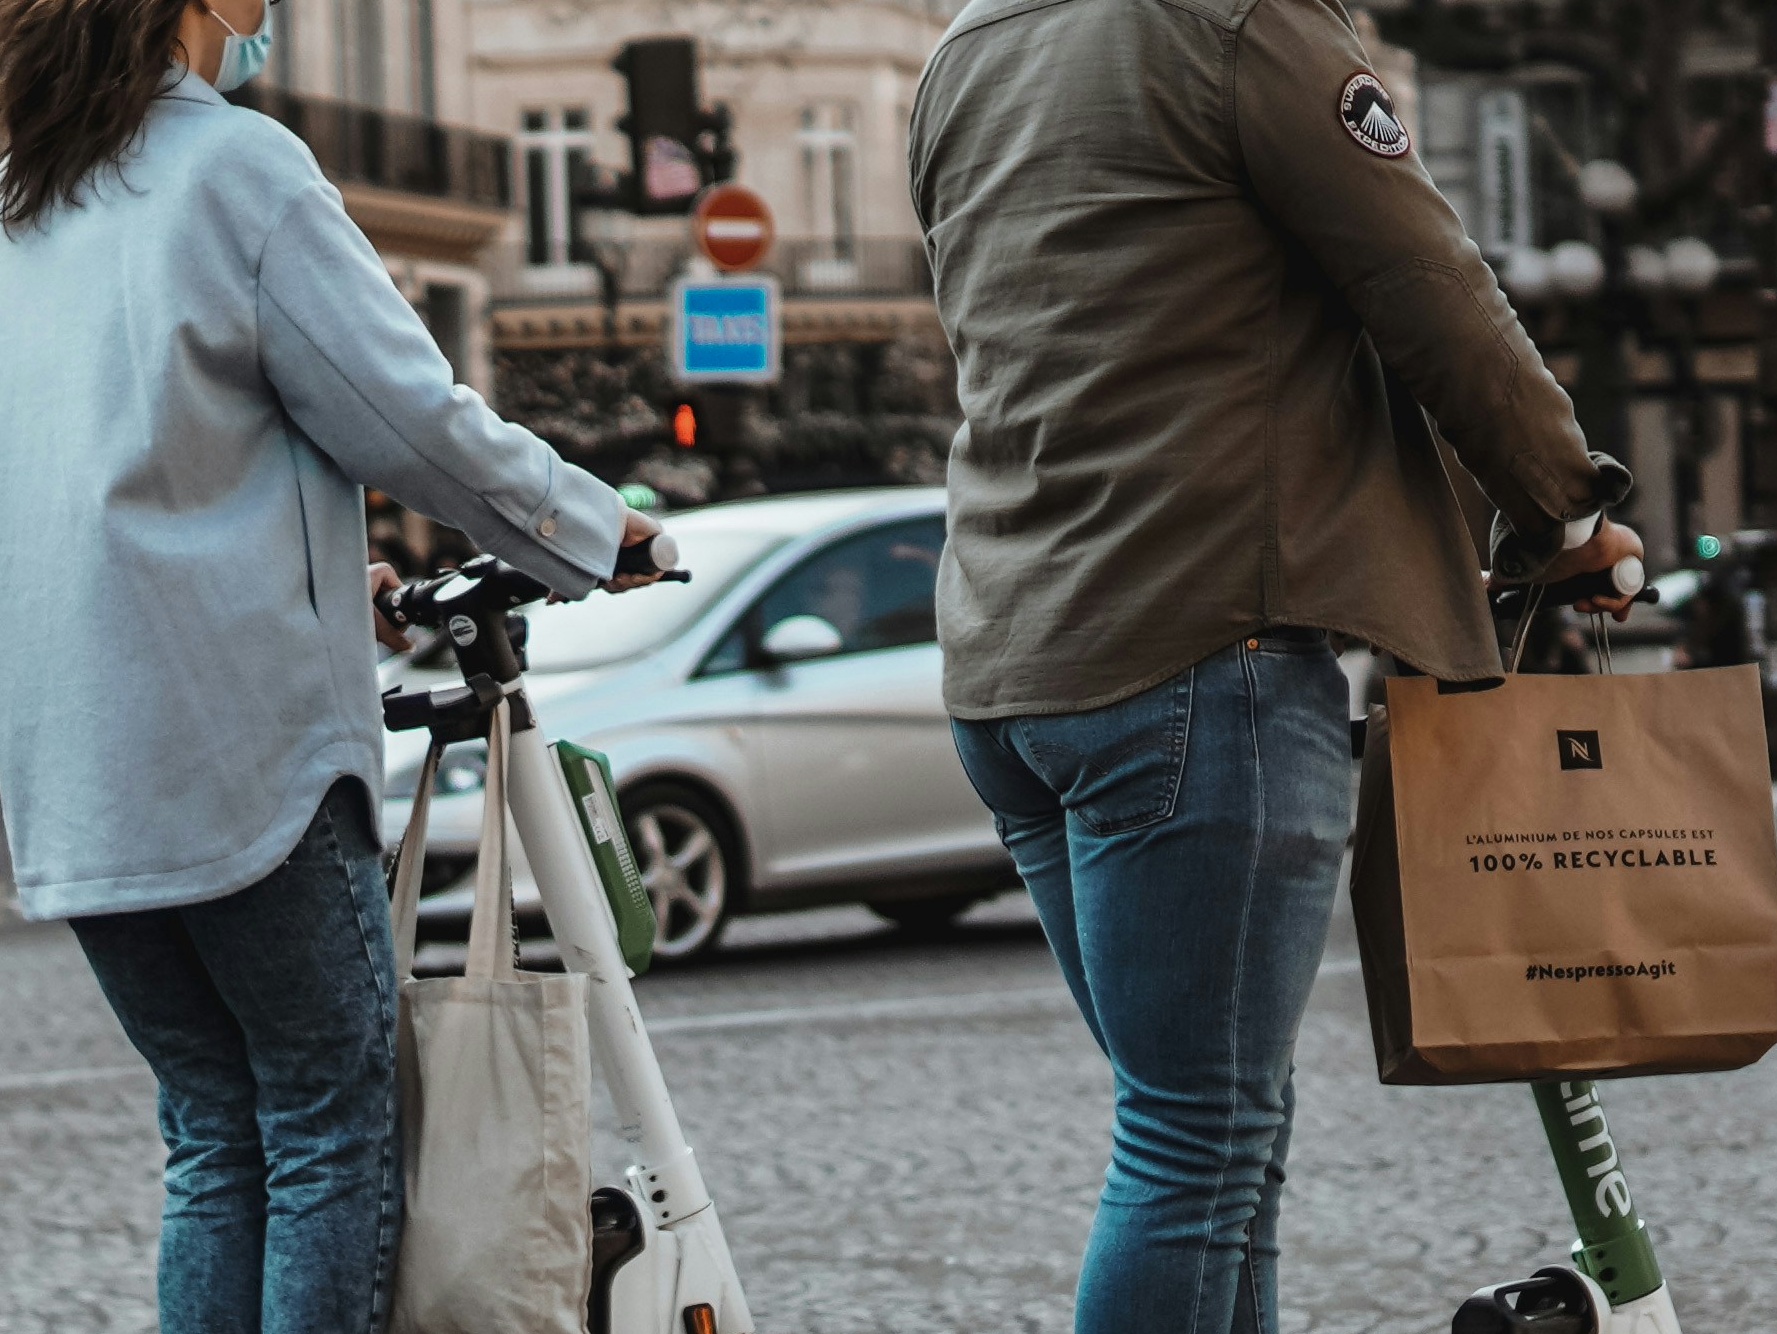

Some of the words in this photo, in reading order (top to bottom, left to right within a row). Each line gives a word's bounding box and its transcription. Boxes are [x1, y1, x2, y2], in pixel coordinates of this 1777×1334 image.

[1466, 833, 1557, 845] L'ALUMINIUM
[1563, 831, 1580, 841] DE
[1585, 829, 1614, 840] NOS
[1619, 829, 1687, 840] CAPSULES
[1692, 829, 1714, 839] EST
[1470, 853, 1543, 873] 100%
[1554, 849, 1718, 869] RECYCLABLE
[1525, 960, 1676, 982] #NespressoAgit
